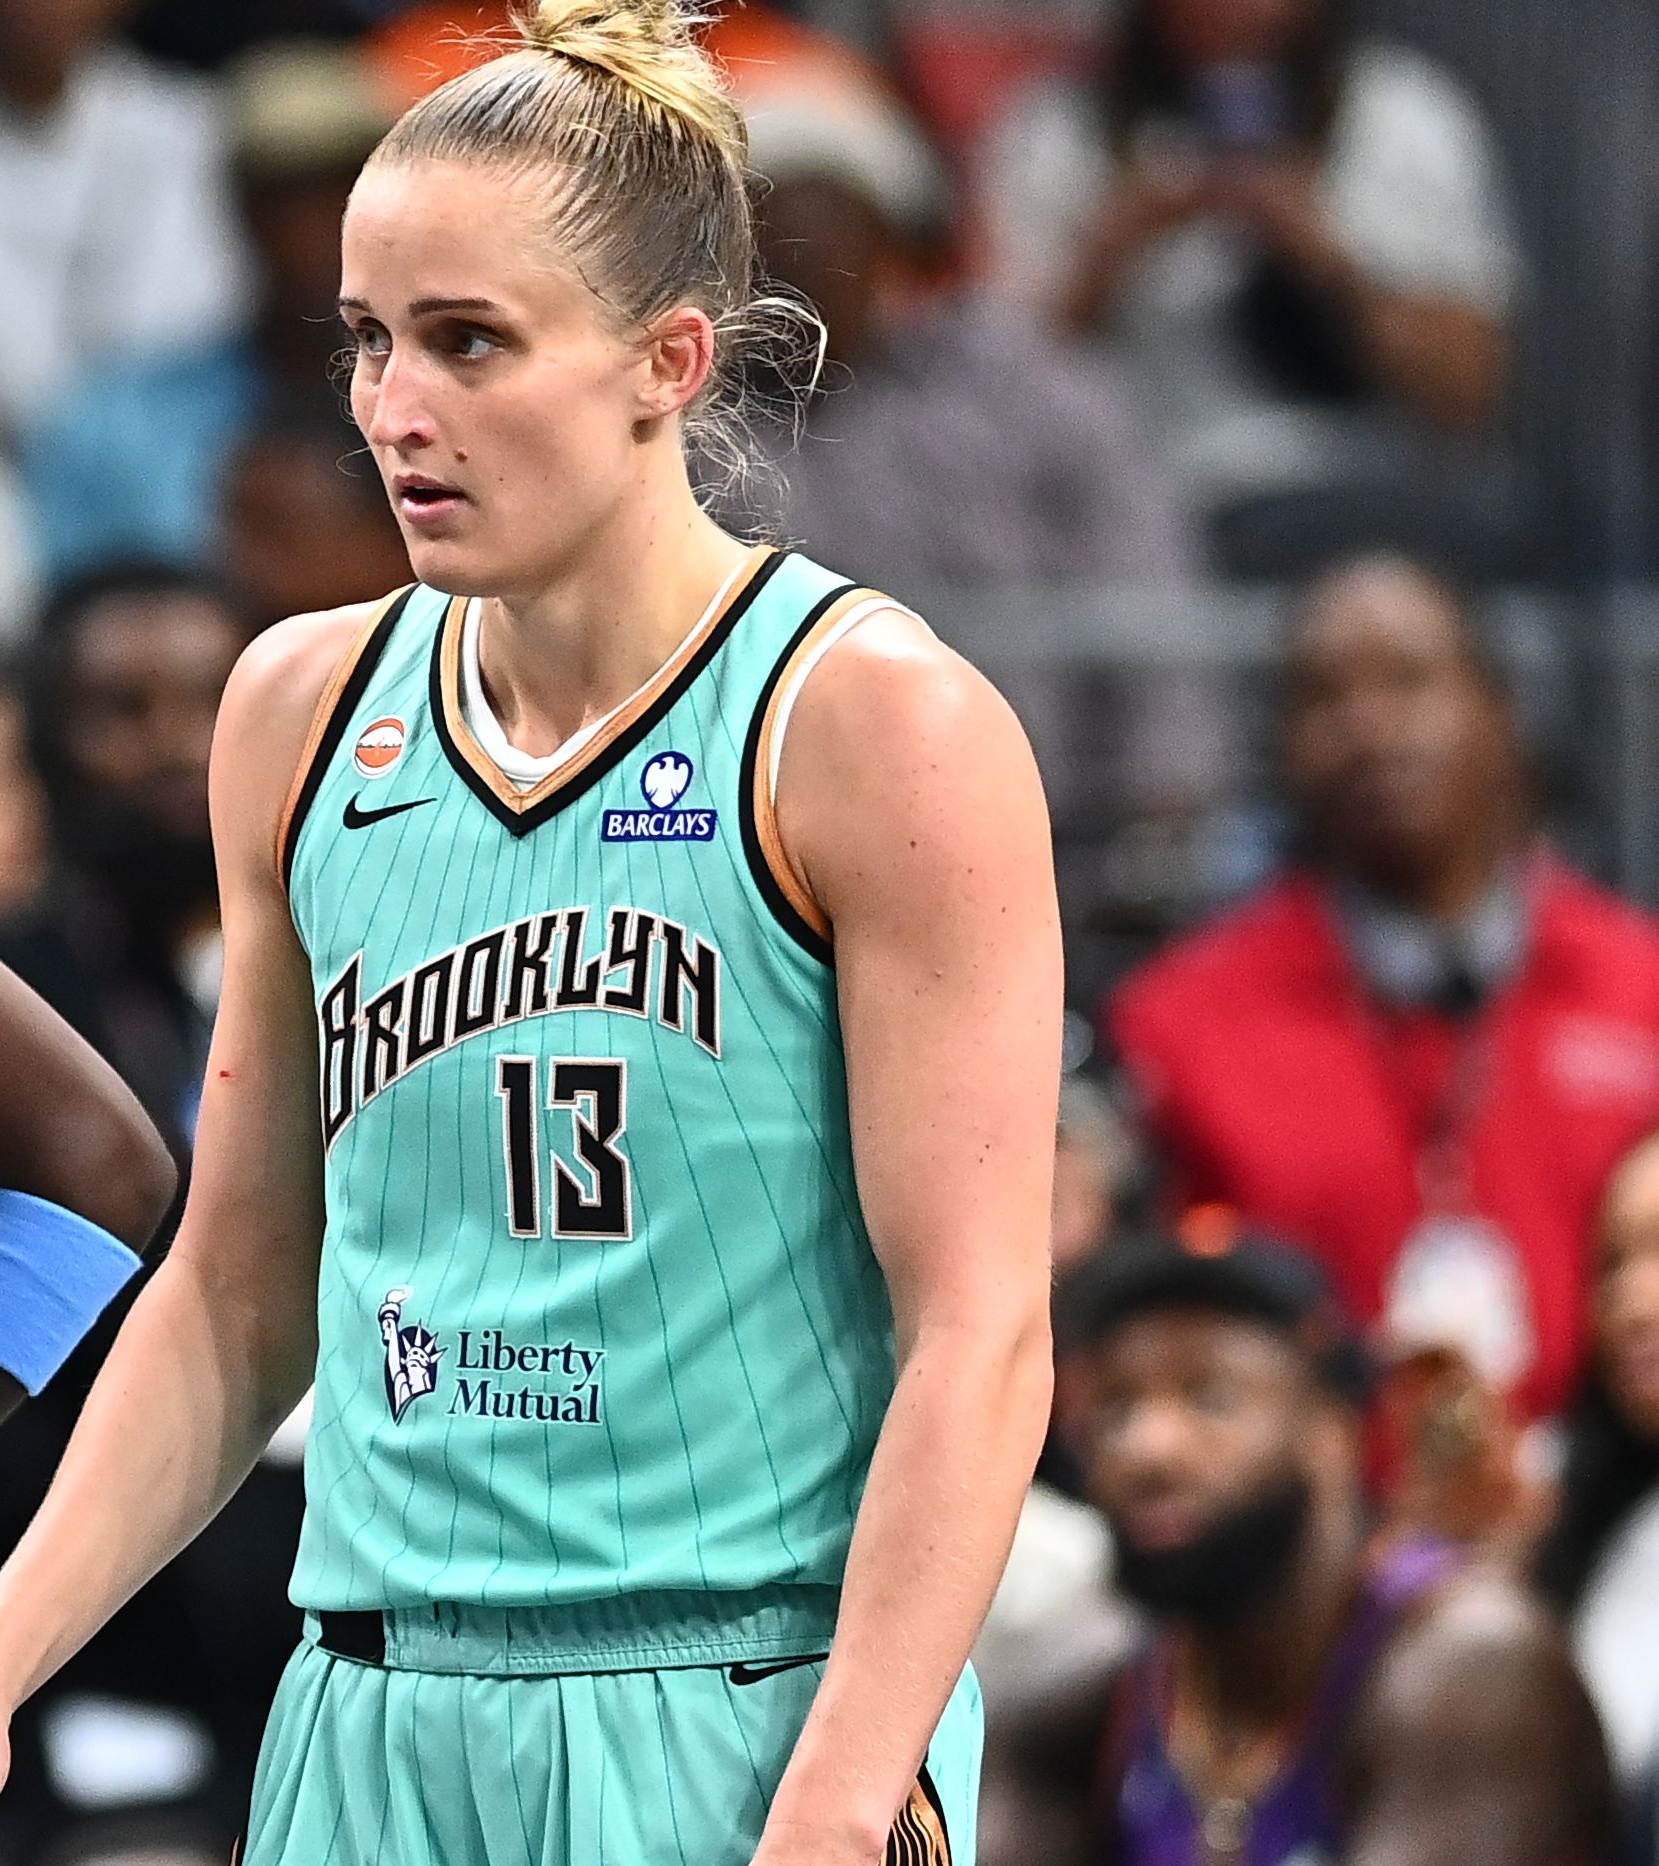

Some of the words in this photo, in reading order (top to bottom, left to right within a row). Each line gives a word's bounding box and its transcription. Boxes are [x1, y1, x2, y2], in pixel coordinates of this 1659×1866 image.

[606, 811, 712, 838] BARCLAYS
[321, 904, 722, 1158] BROOKLYN
[495, 1053, 634, 1241] 13
[455, 1330, 604, 1393] Liberty
[447, 1378, 603, 1424] Mutual
